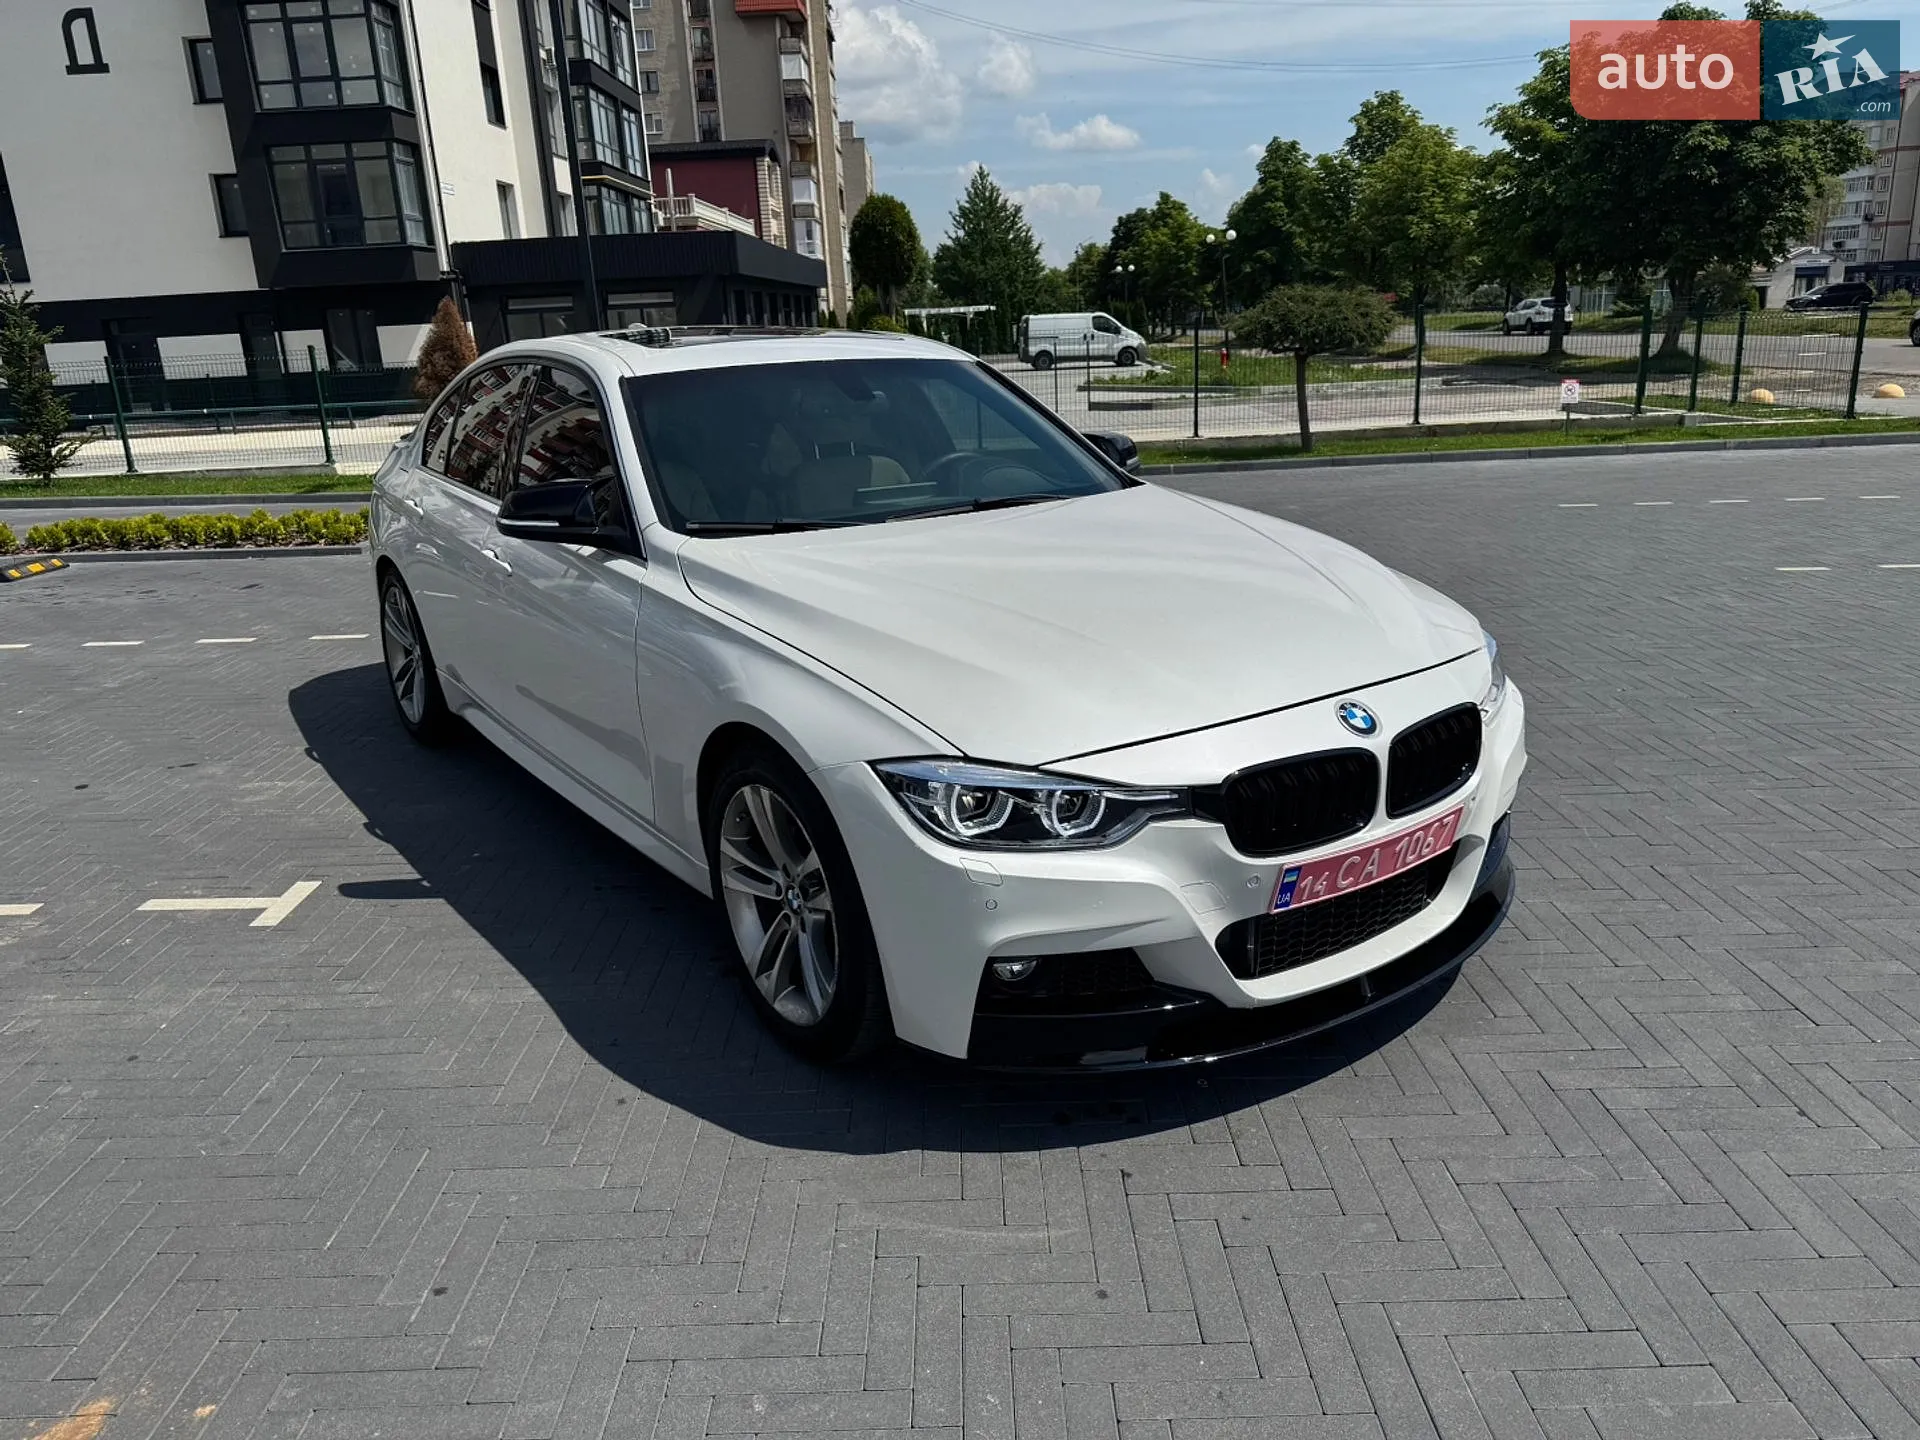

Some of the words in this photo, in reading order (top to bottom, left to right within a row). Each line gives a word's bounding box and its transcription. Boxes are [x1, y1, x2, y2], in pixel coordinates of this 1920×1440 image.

[1300, 871, 1330, 900] 14
[1335, 847, 1381, 889] CA
[1394, 814, 1456, 868] 1067
[1277, 894, 1291, 904] UA
